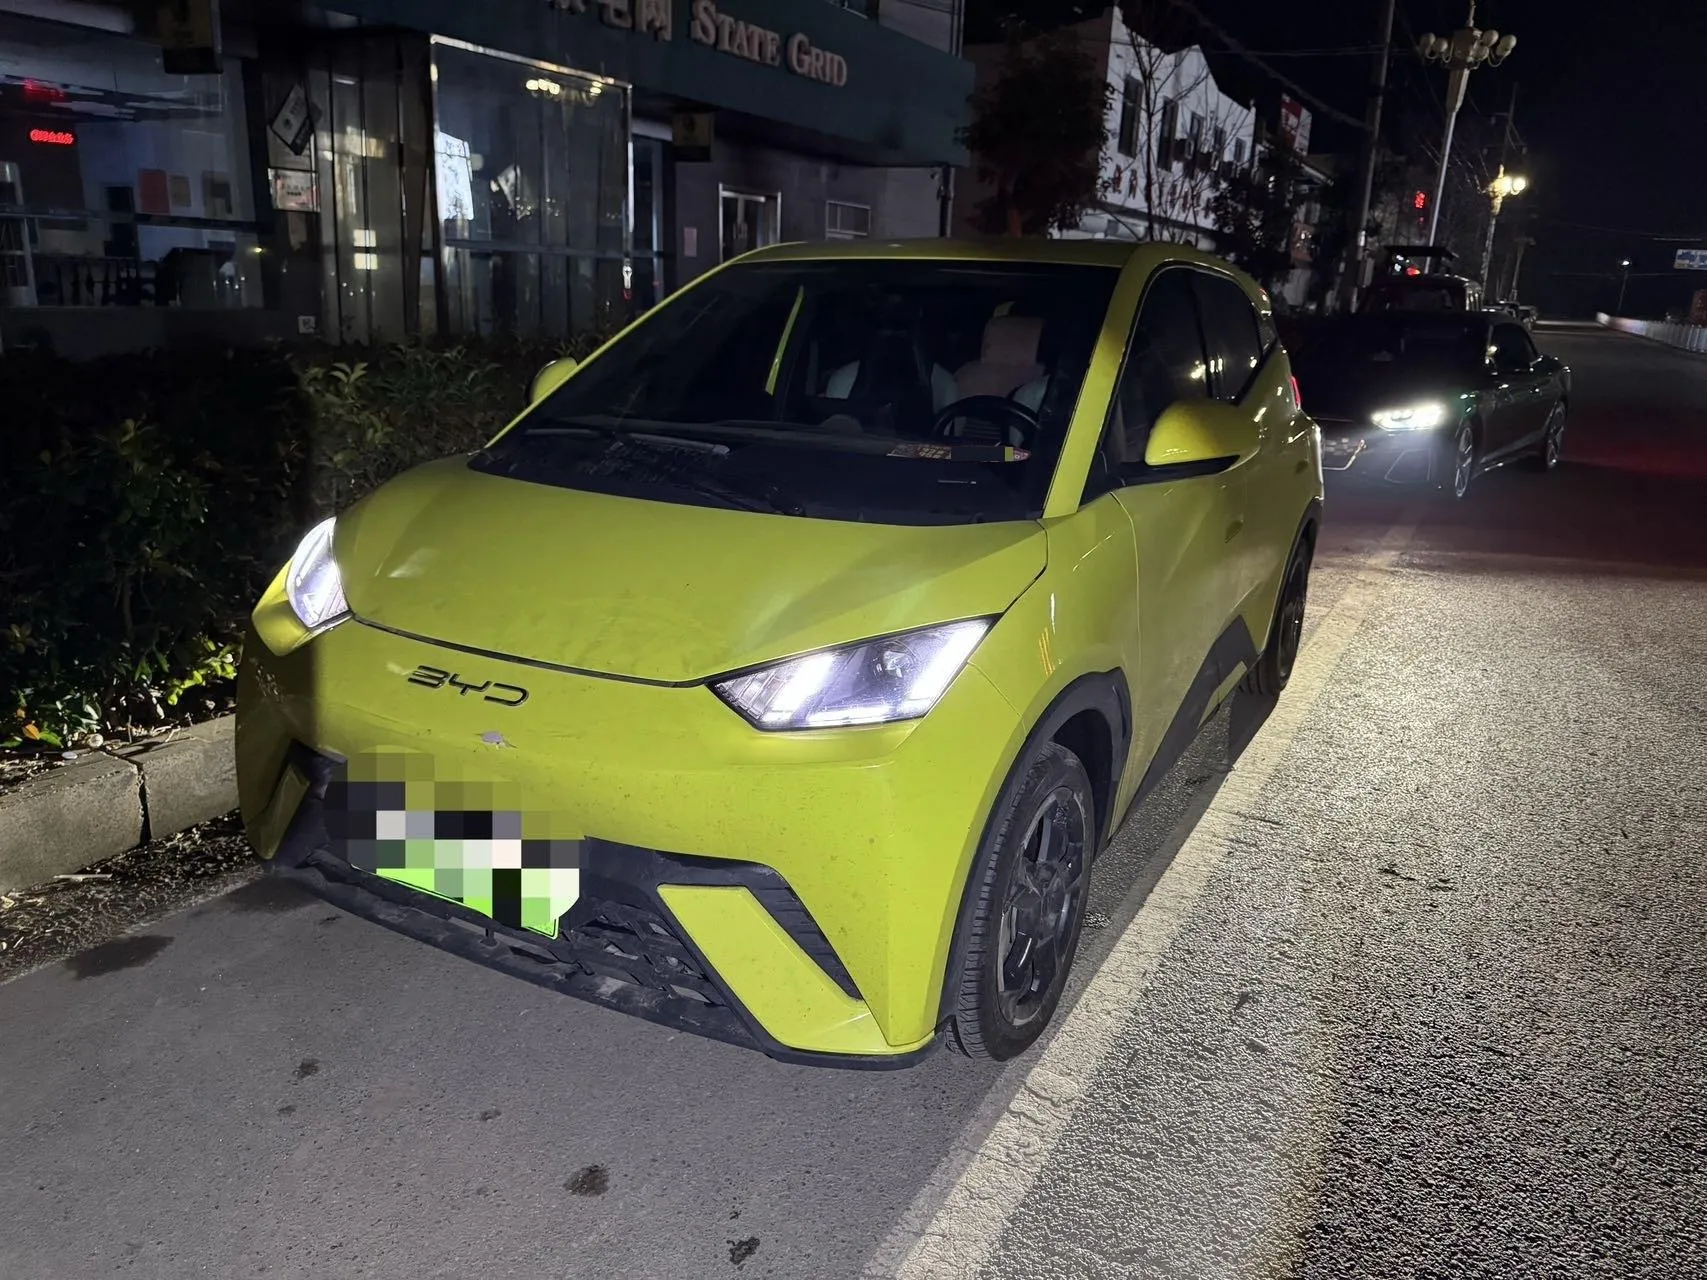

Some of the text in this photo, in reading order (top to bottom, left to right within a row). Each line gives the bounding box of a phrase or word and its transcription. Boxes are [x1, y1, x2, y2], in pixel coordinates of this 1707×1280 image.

[690, 0, 848, 87] STATE GRID
[408, 664, 530, 707] BYD
